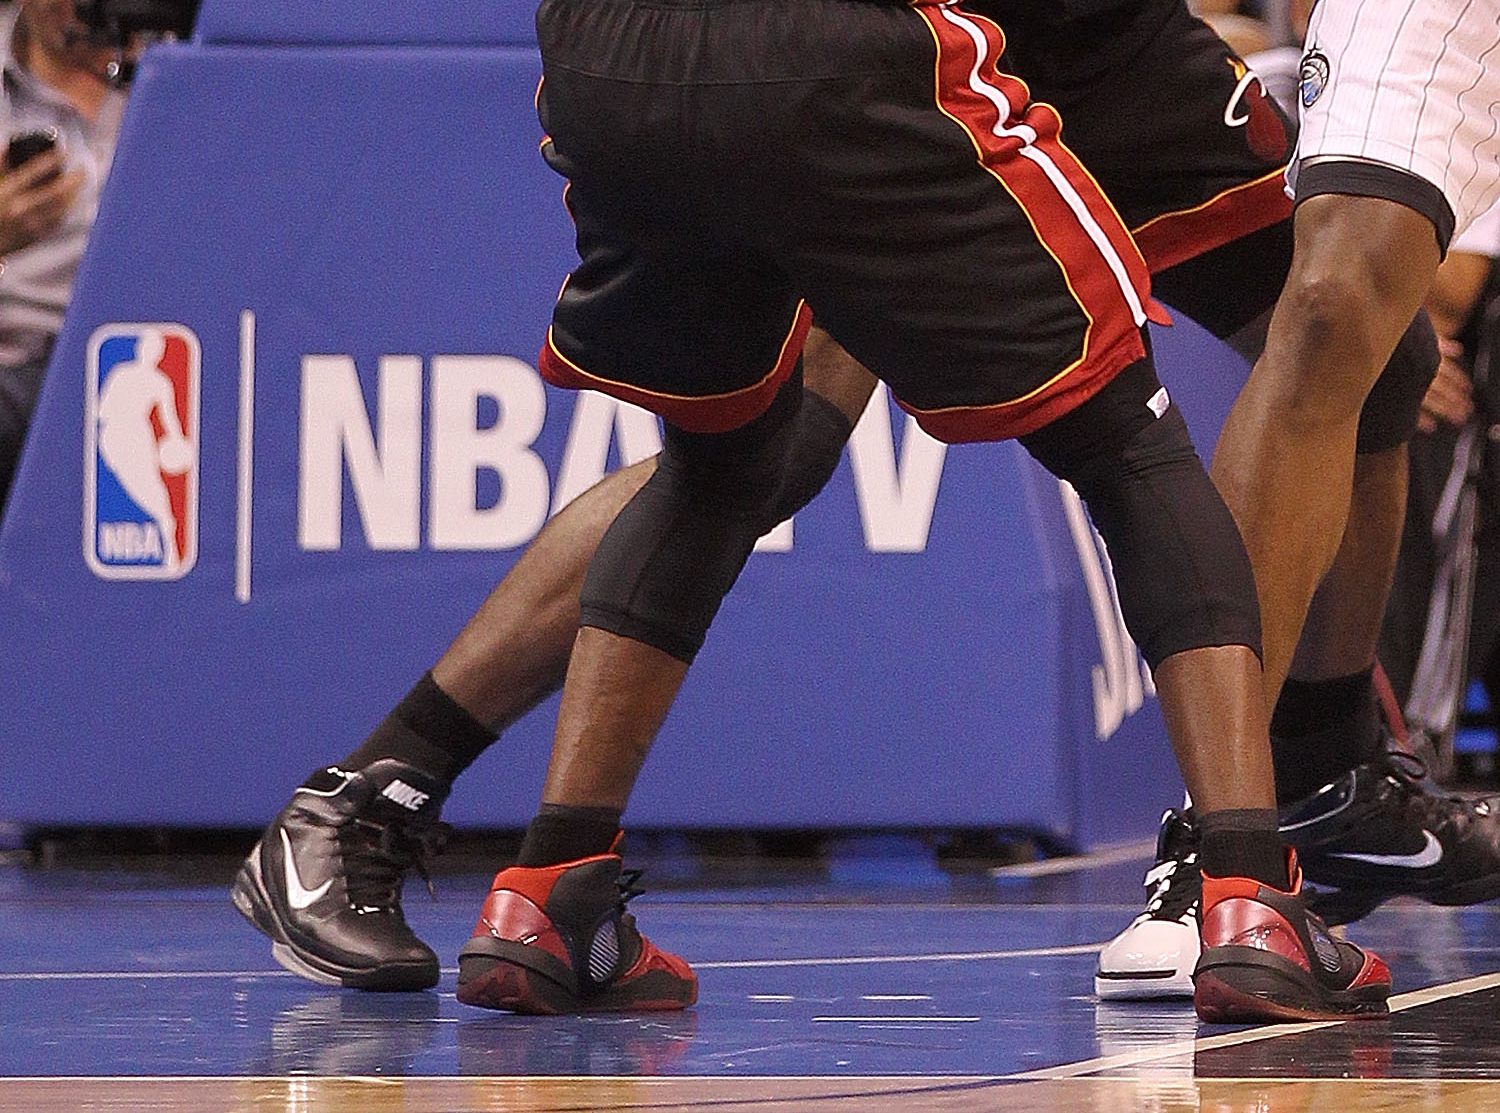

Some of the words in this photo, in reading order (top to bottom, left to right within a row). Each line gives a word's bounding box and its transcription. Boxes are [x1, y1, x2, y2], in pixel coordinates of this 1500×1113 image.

[752, 378, 949, 554] V
[101, 522, 161, 563] NBA
[382, 778, 430, 812] NIKE
